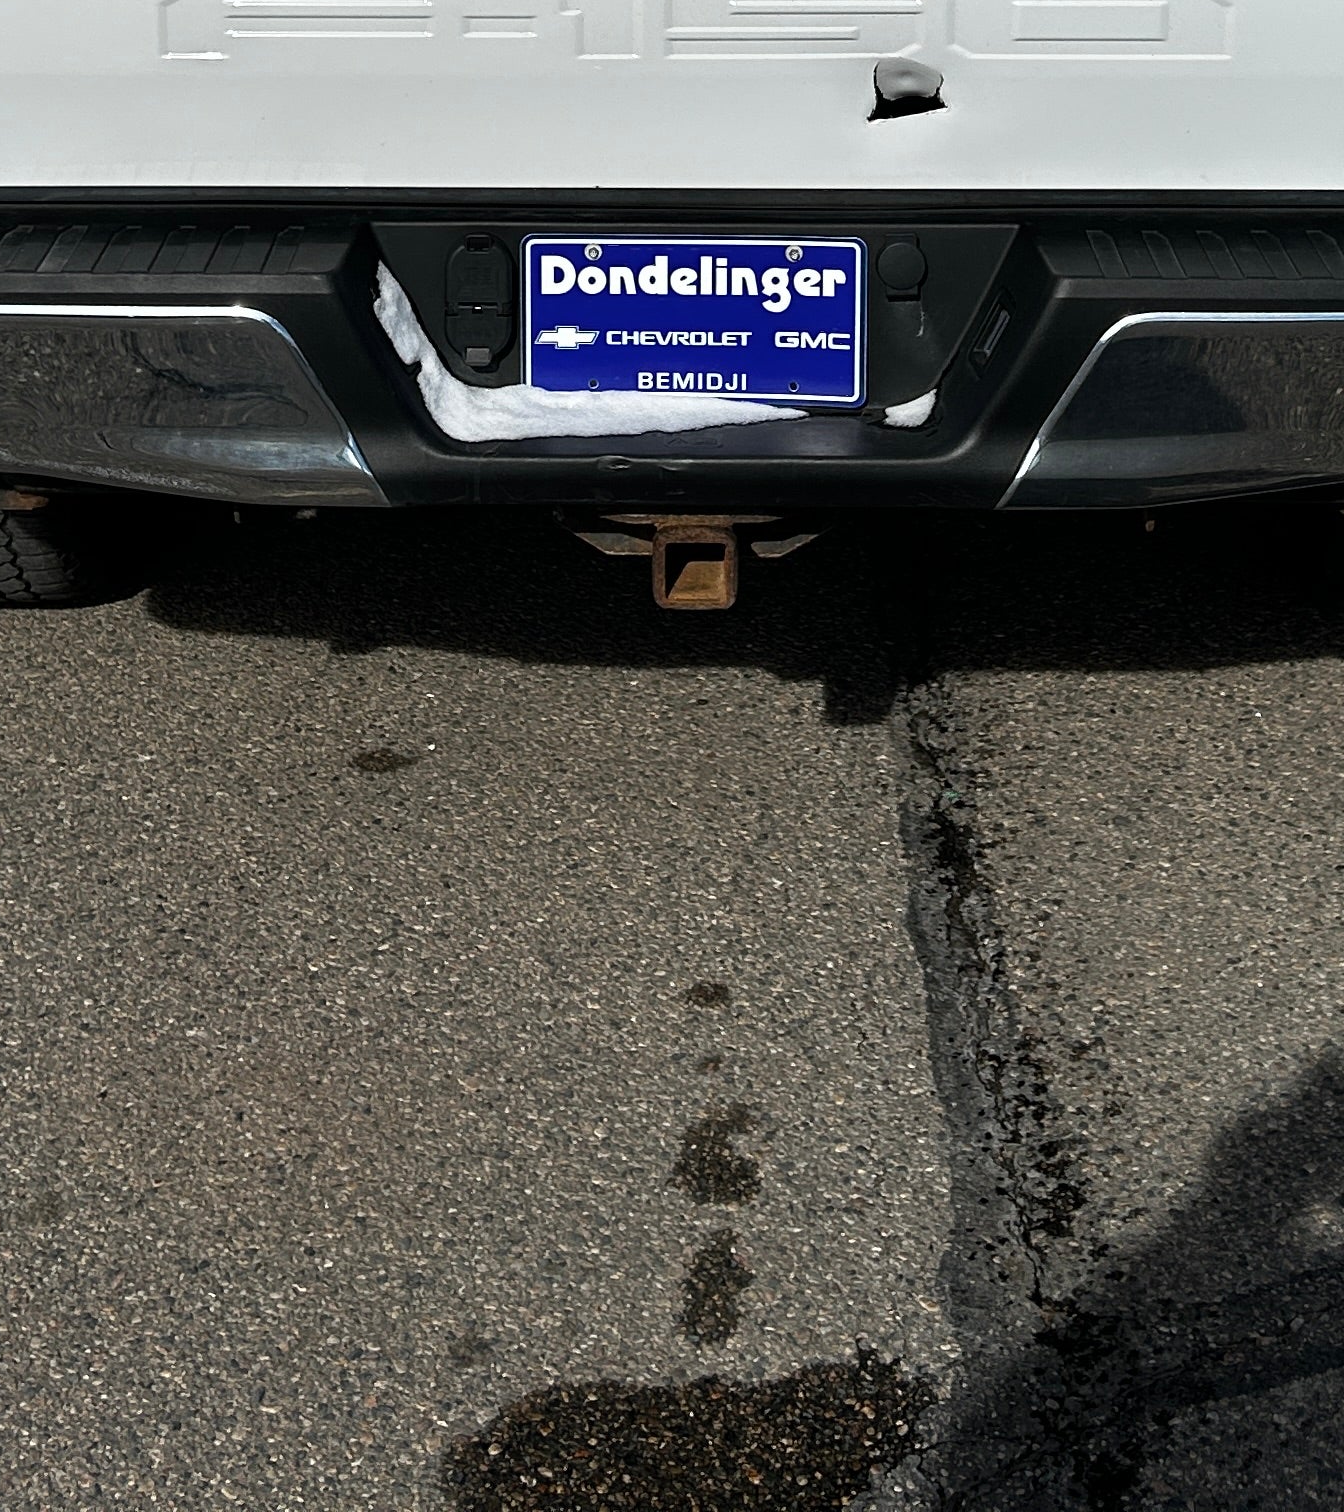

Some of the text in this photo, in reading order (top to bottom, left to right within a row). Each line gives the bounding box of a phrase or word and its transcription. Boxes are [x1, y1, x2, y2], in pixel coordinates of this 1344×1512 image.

[540, 255, 846, 313] Dondelinger
[606, 330, 851, 350] CHEVROLET GMC
[637, 372, 748, 391] BEMIDJI
